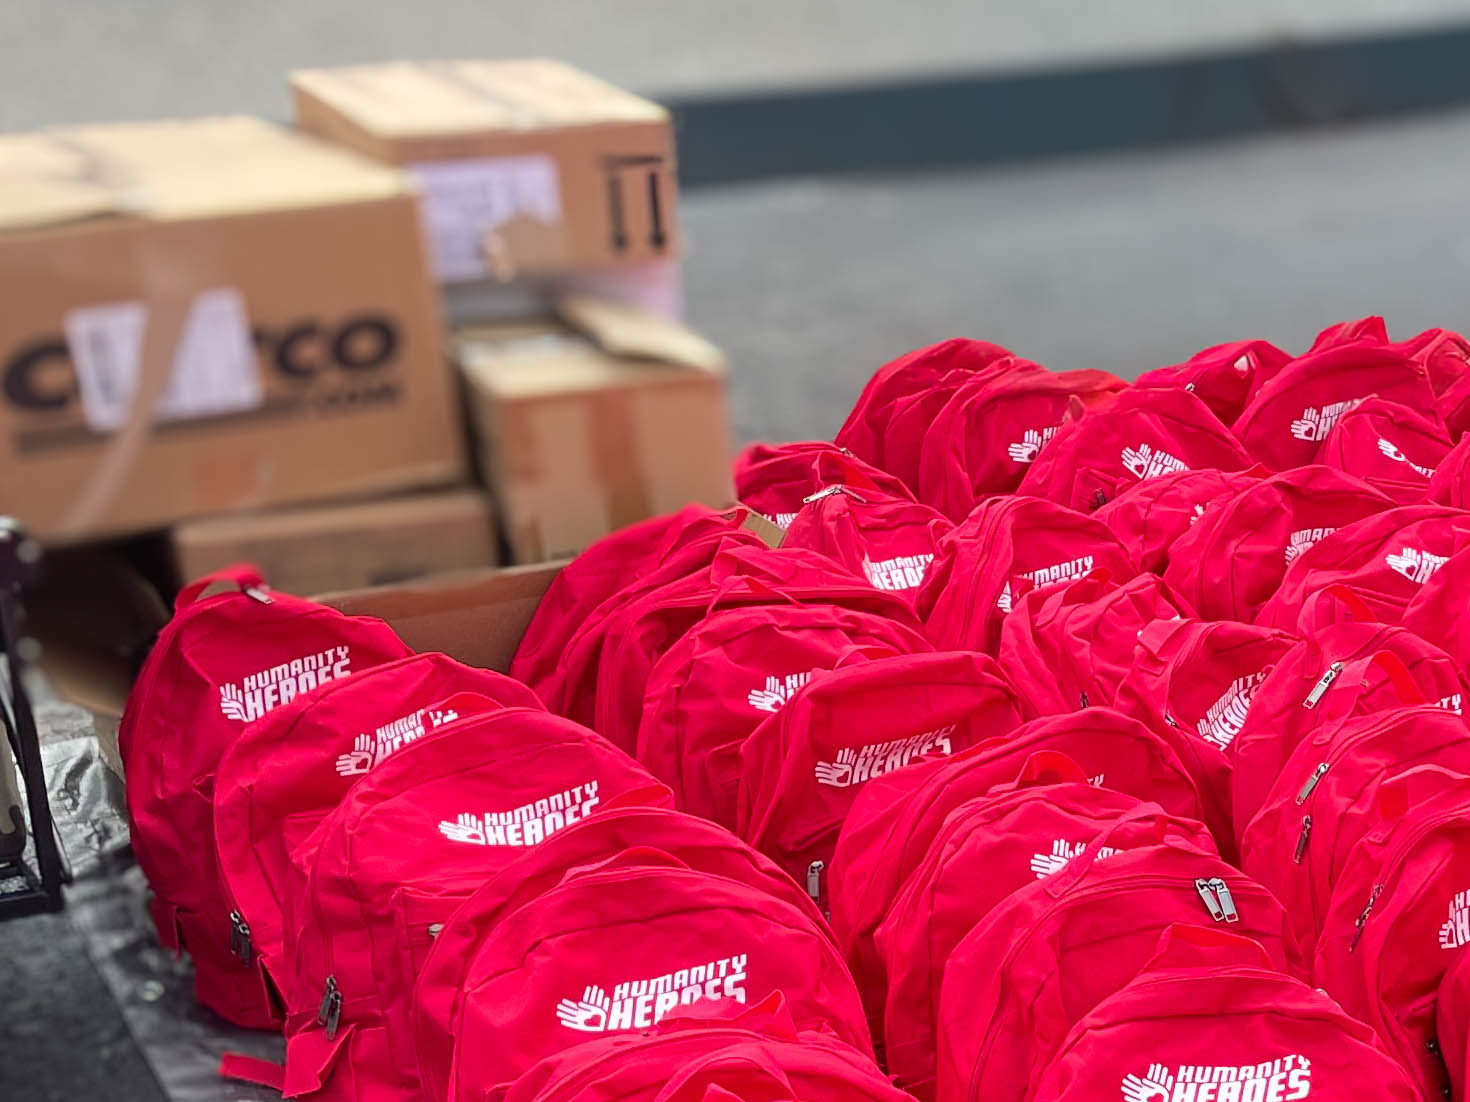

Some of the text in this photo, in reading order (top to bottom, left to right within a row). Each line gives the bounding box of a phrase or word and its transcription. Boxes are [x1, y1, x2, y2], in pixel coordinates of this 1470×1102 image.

[3, 314, 397, 412] CCO
[244, 646, 350, 697] HUMANITY
[486, 780, 597, 827] HUMANITY
[612, 953, 747, 1003] HUMANITY
[1176, 1055, 1311, 1084] HUMANITY
